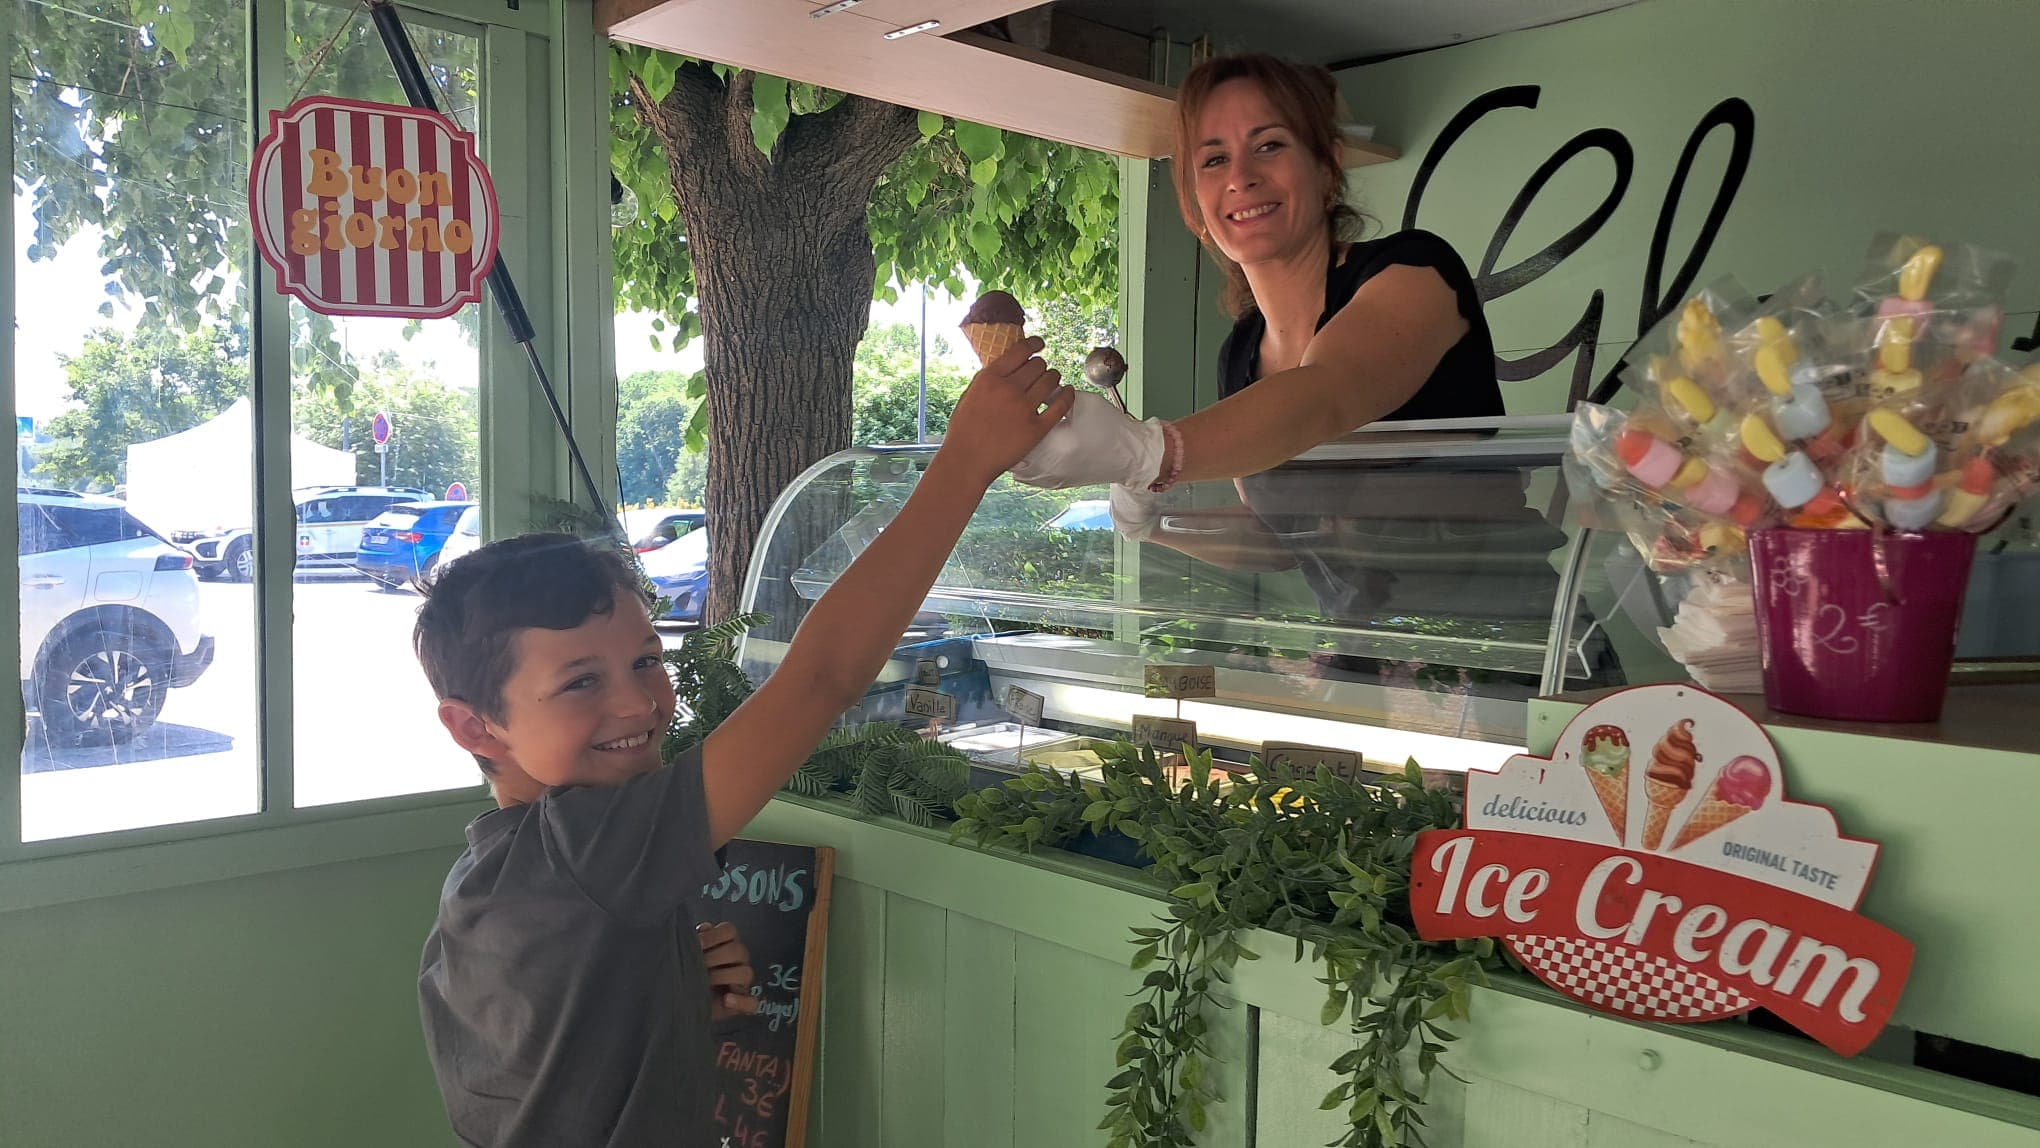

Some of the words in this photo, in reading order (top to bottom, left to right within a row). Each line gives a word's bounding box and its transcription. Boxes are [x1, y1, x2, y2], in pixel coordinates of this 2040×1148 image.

[306, 148, 452, 207] Buon
[291, 201, 474, 257] giorno
[910, 694, 947, 714] Vanille
[1483, 793, 1588, 827] delicious
[1722, 841, 1789, 873] ORIGINAL
[1790, 859, 1840, 891] TASTE
[1430, 836, 1550, 924] Ice
[1575, 855, 1882, 1024] Cream
[767, 964, 800, 990] 3€
